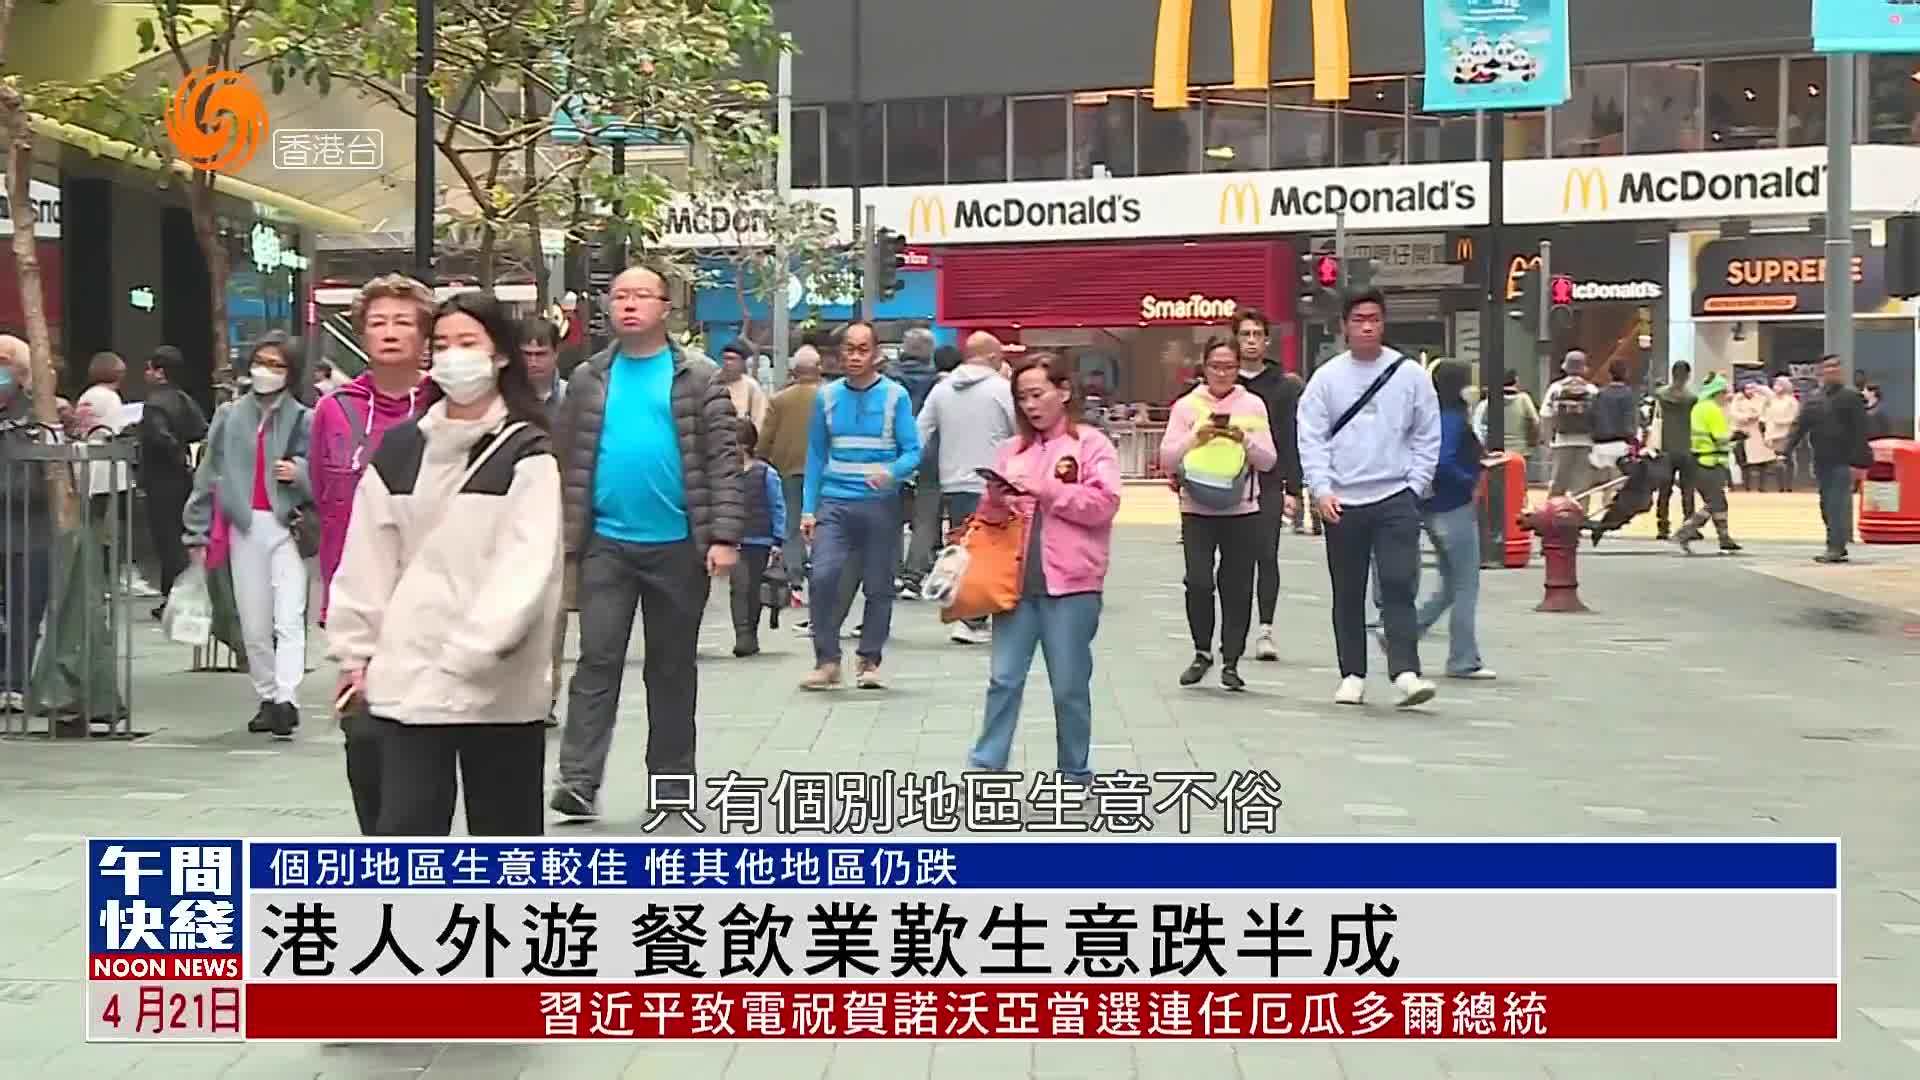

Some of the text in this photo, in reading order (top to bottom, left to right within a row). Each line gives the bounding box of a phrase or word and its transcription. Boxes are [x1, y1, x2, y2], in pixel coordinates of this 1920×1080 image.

[1270, 180, 1476, 216] McDonald's
[1618, 164, 1829, 203] McDonald'
[665, 203, 838, 234] McDon's
[954, 194, 1141, 228] McDonald's
[1727, 257, 1863, 285] SUPREE
[1572, 281, 1663, 299] cDonald's
